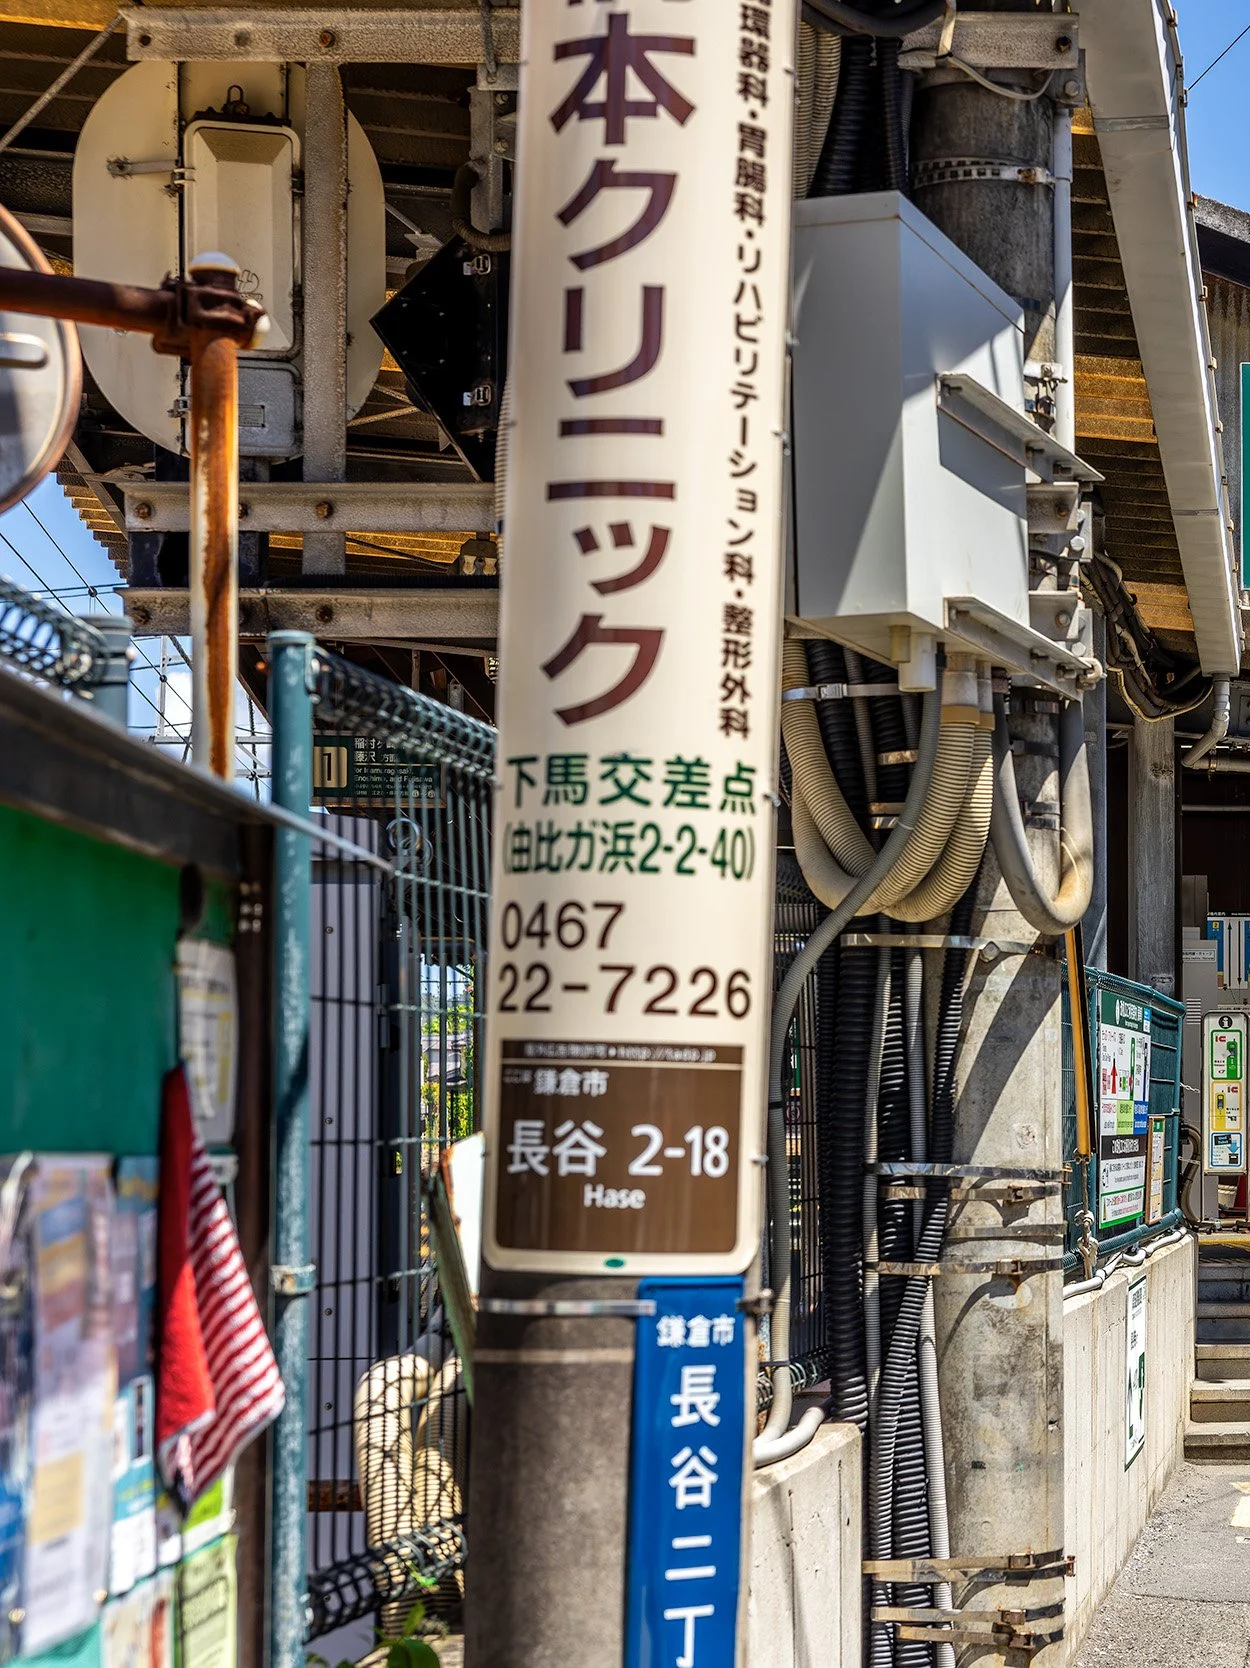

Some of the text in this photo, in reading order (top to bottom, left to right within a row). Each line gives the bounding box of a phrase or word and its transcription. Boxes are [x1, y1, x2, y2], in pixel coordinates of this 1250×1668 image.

[541, 0, 696, 727] 本クリニック
[720, 0, 772, 741] 環器科・胃腸科・リハビリテーション科・整形外科
[506, 752, 757, 815] 下馬交差点
[501, 902, 625, 950] 0467
[498, 962, 751, 1020] 22-7226
[533, 1068, 610, 1096] 鎌倉市
[506, 1119, 730, 1178] 長谷 2-18
[583, 1183, 647, 1209] Hase
[656, 1314, 735, 1347] 鎌倉市
